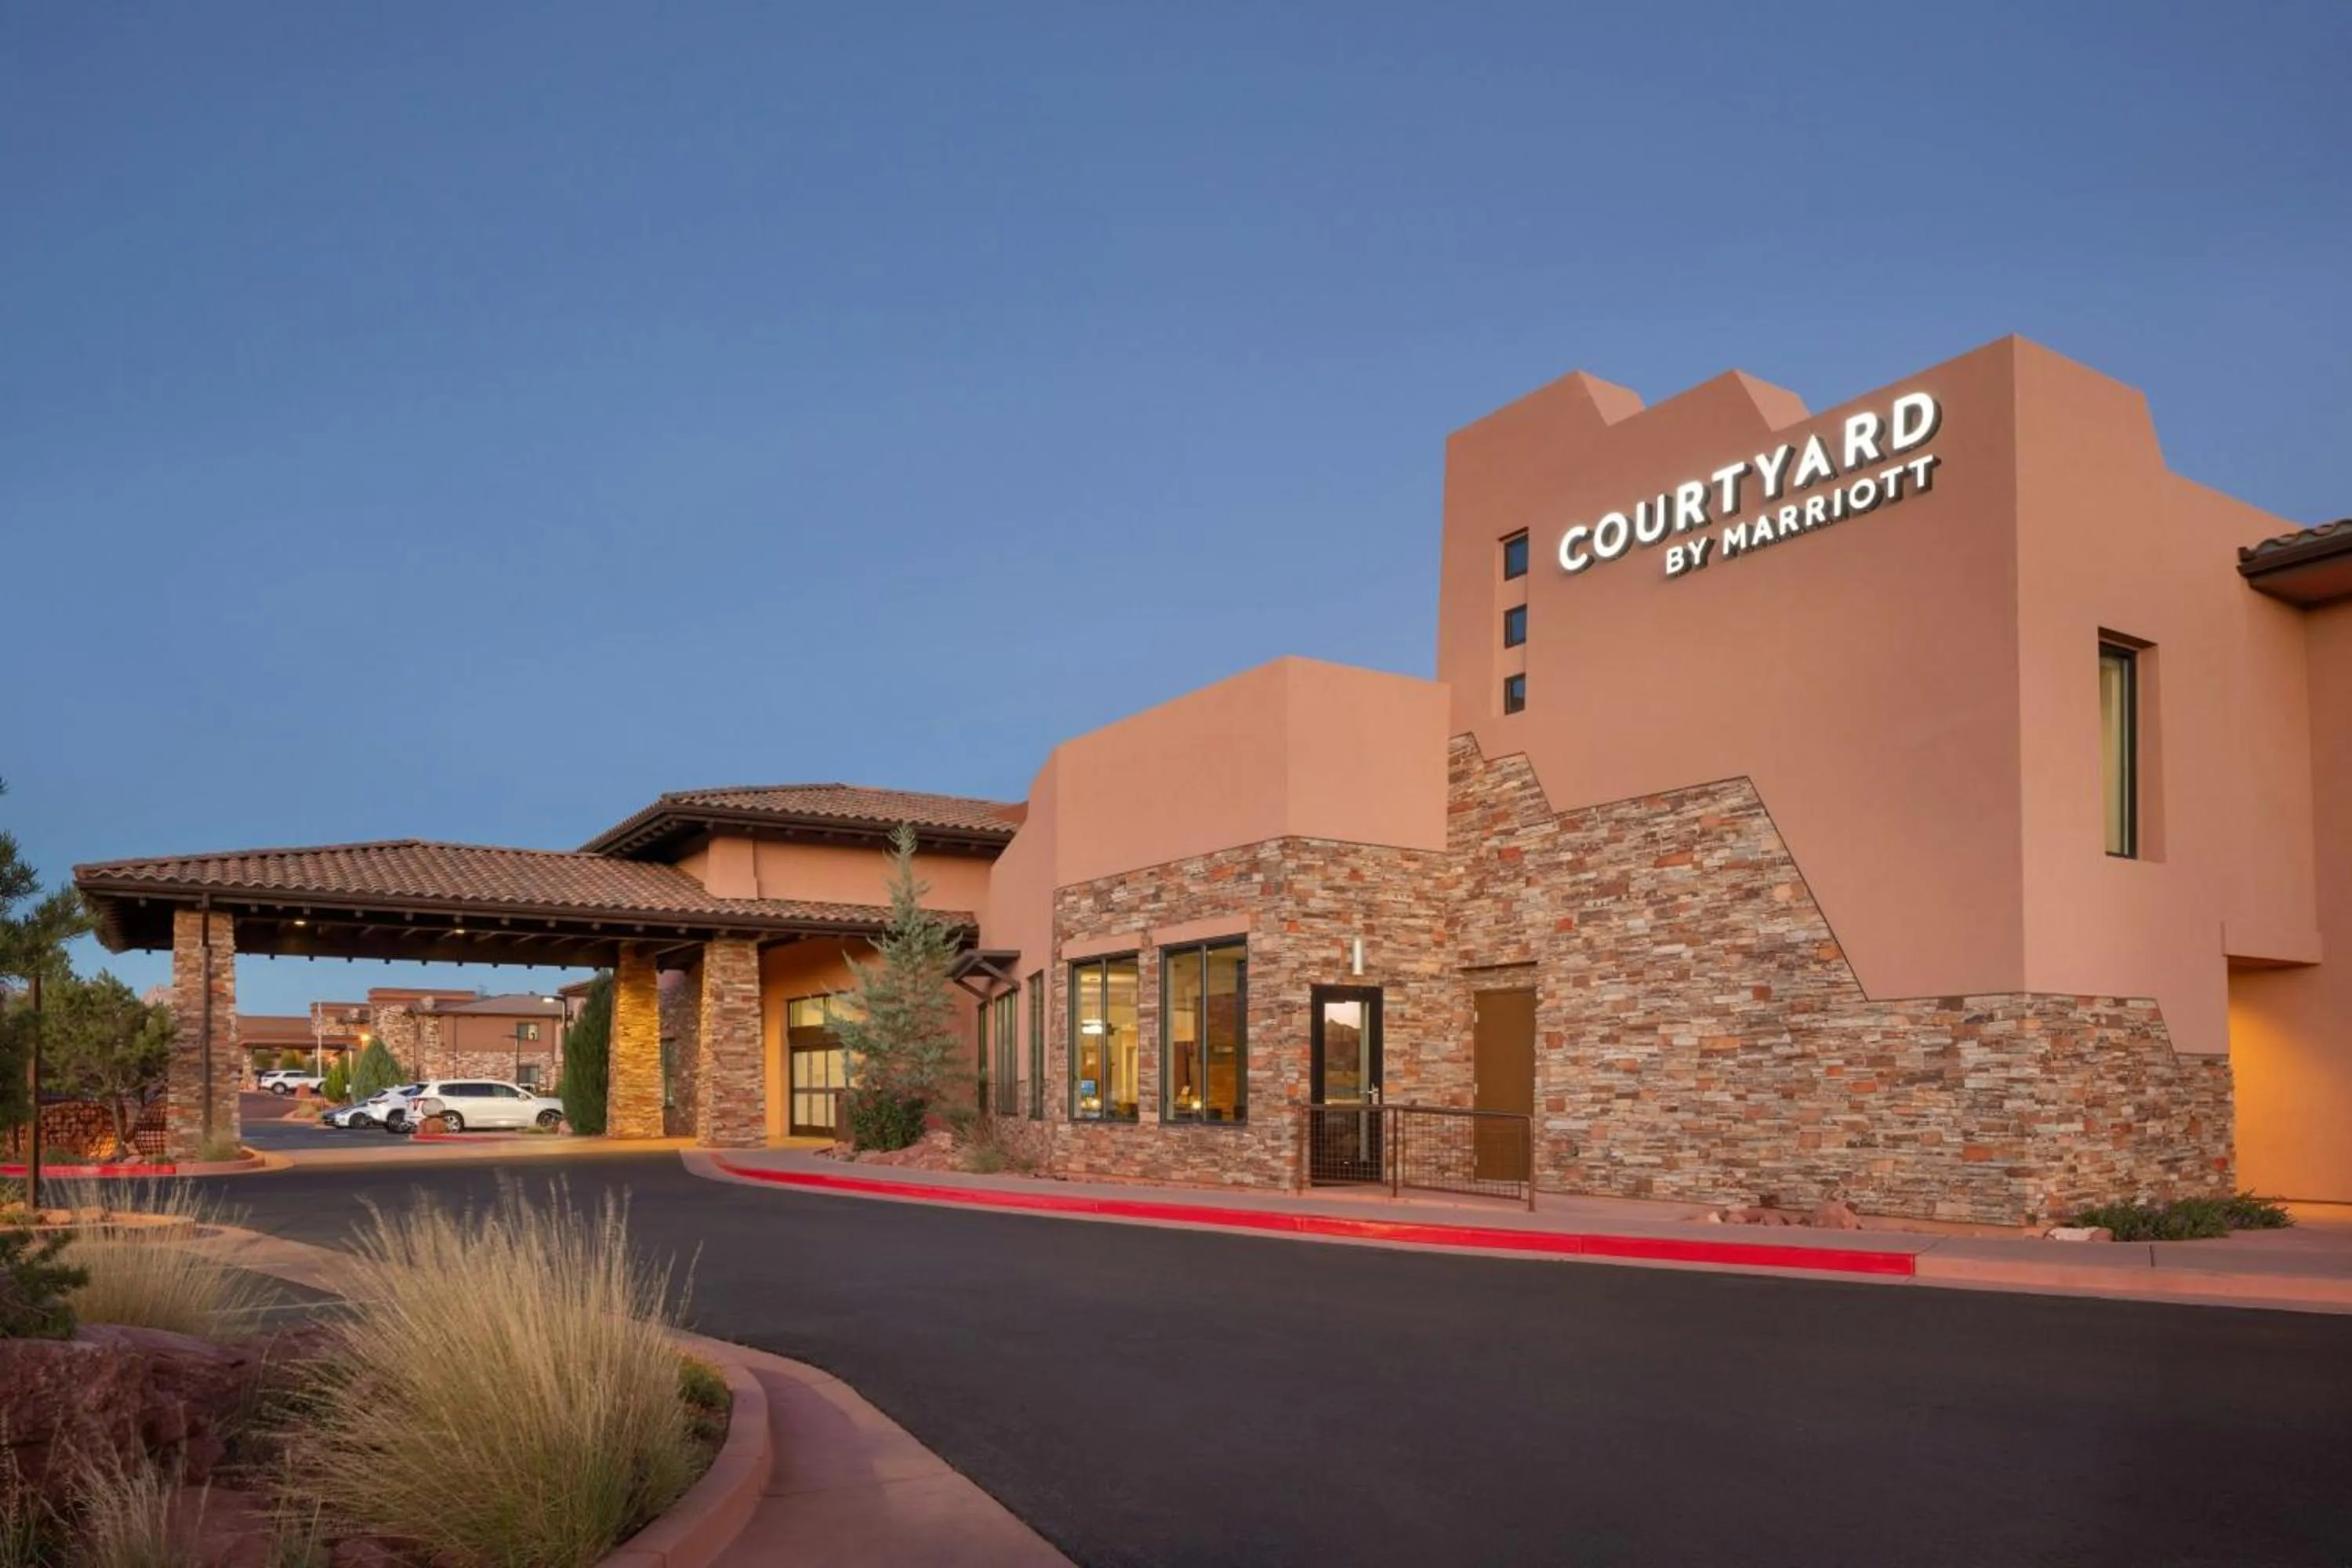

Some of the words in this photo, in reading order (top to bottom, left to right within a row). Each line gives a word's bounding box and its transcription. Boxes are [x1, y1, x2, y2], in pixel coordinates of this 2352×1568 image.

[1559, 392, 1937, 572] COURTYARD
[1666, 536, 1712, 576] BY
[1722, 455, 1936, 557] MARRIOTT
